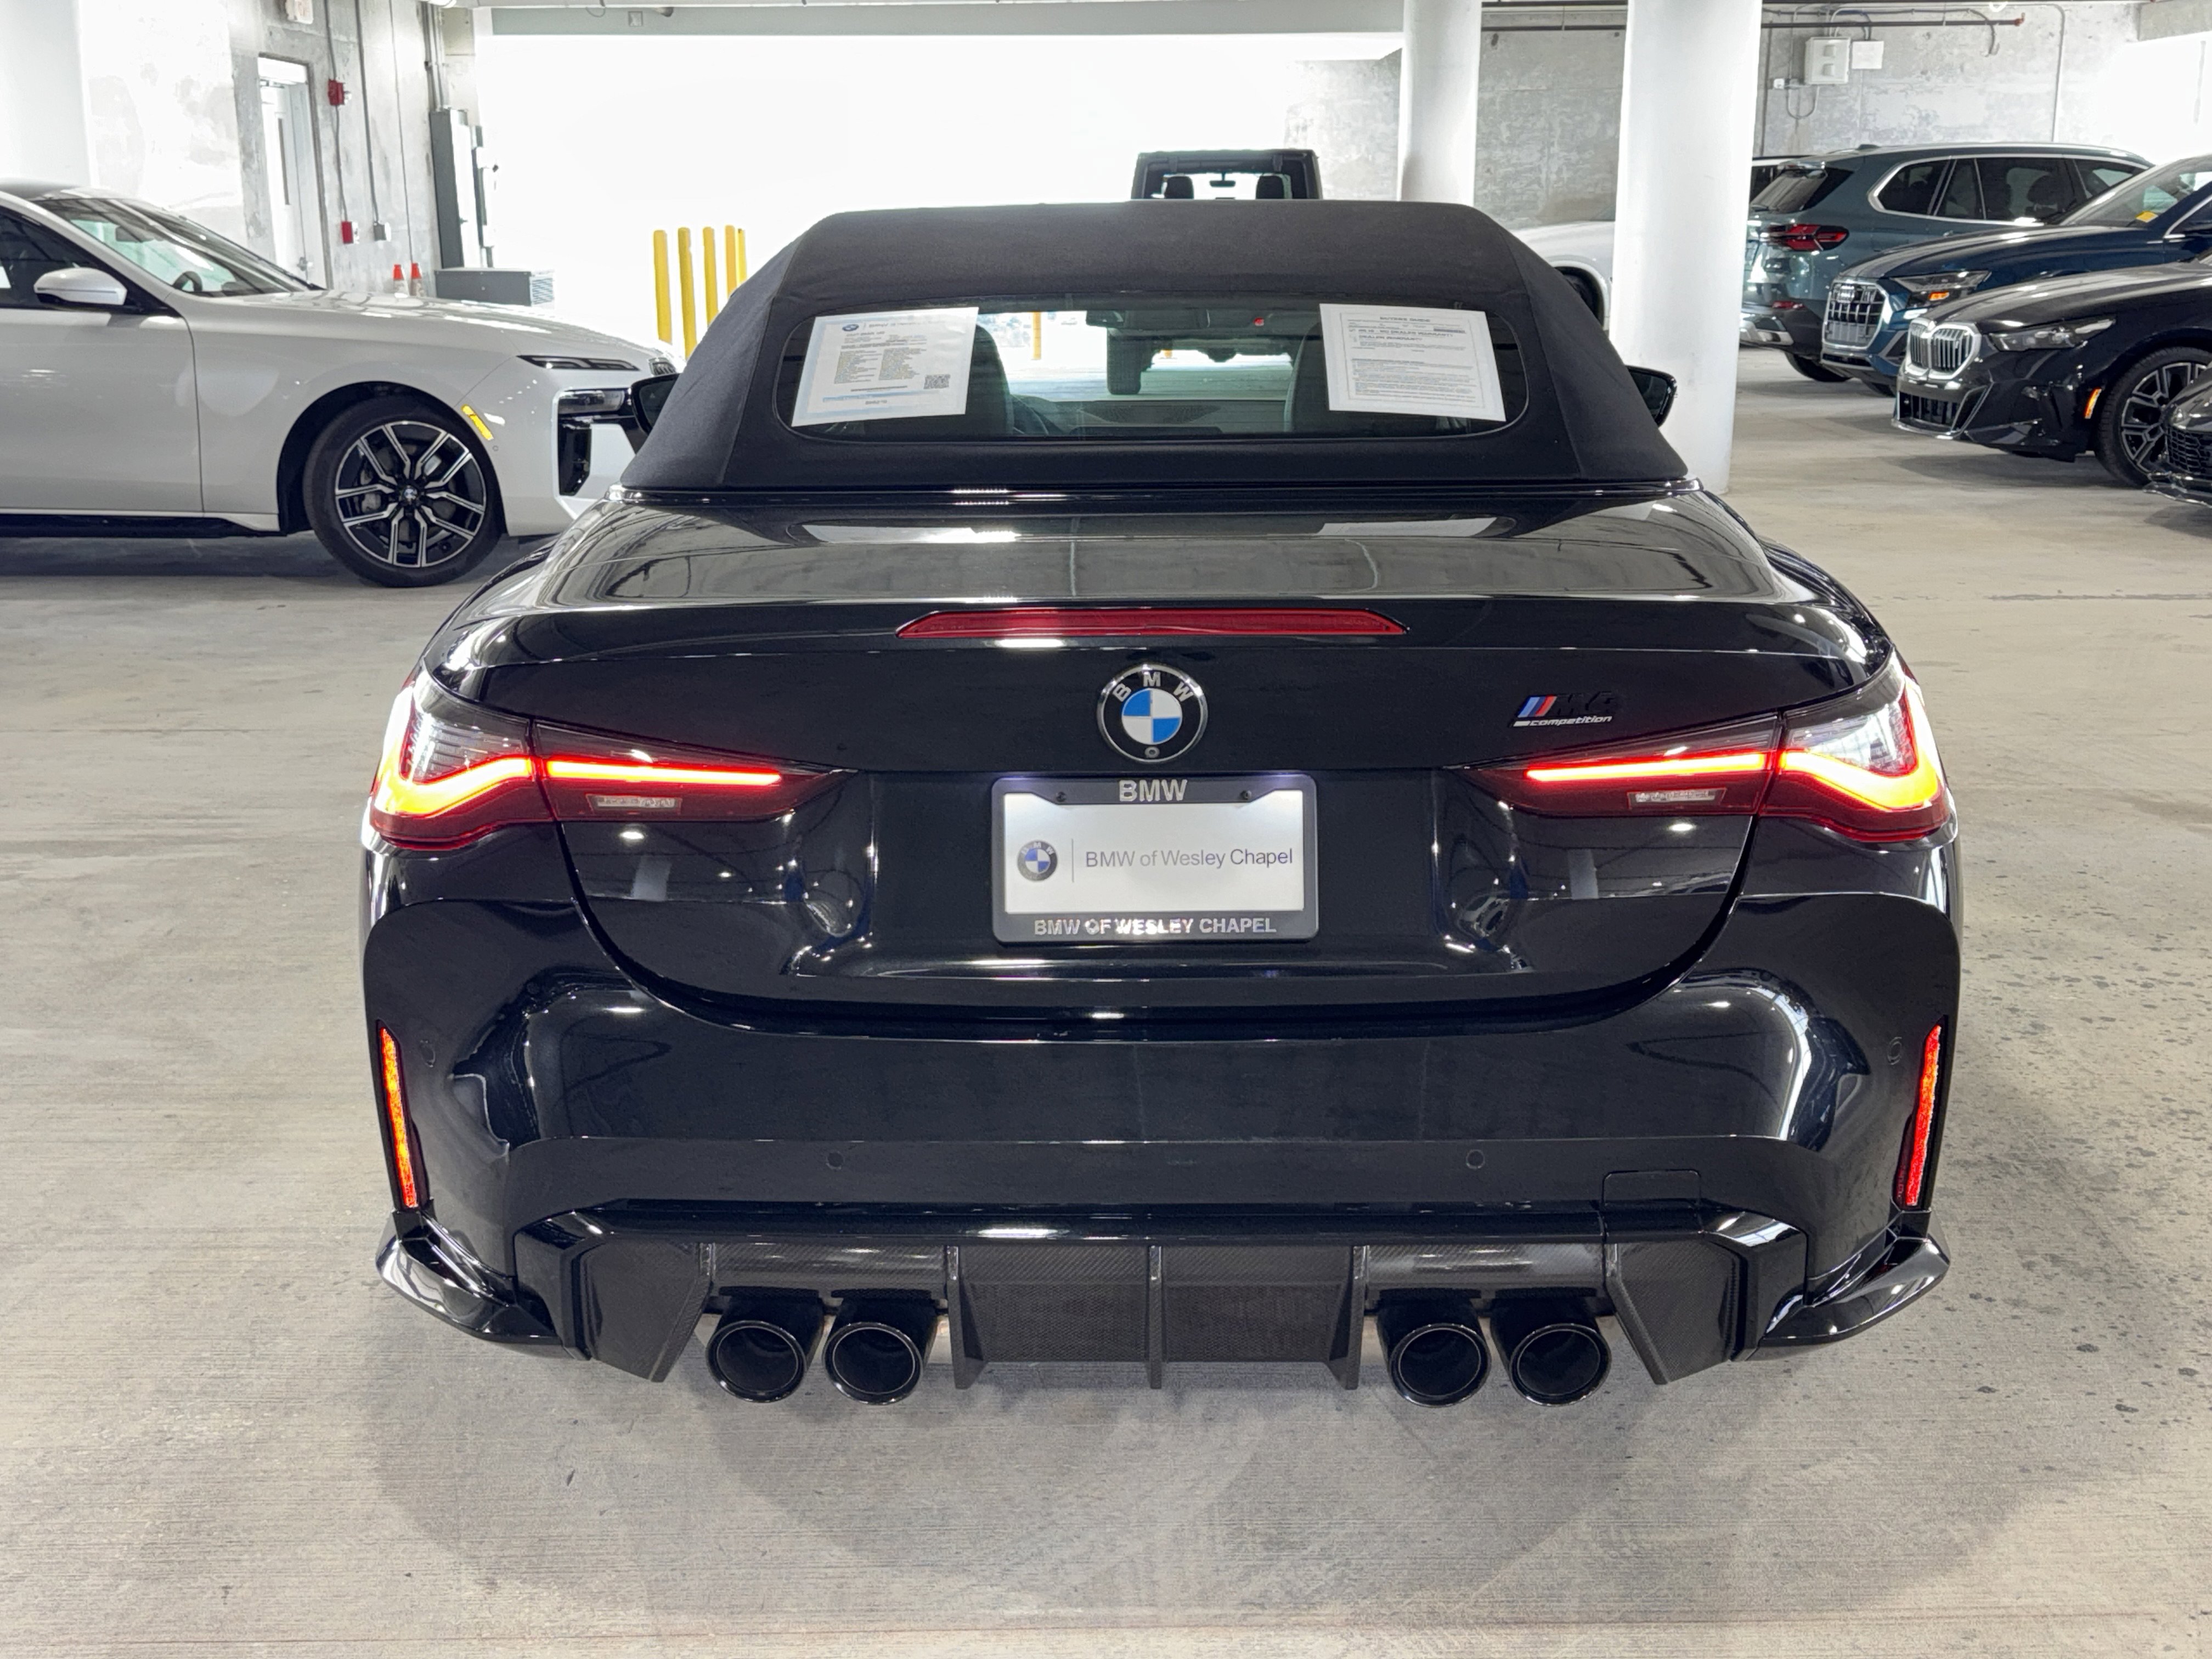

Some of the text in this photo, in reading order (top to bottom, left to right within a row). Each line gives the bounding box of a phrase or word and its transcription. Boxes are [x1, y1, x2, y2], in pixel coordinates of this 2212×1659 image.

[1113, 672, 1194, 702] BMW
[1530, 715, 1612, 726] competition
[1119, 779, 1188, 802] BMW
[1086, 848, 1293, 869] BMW of Wesley Chapel
[1034, 918, 1277, 935] BMW OF WESLEY CHAPEL
